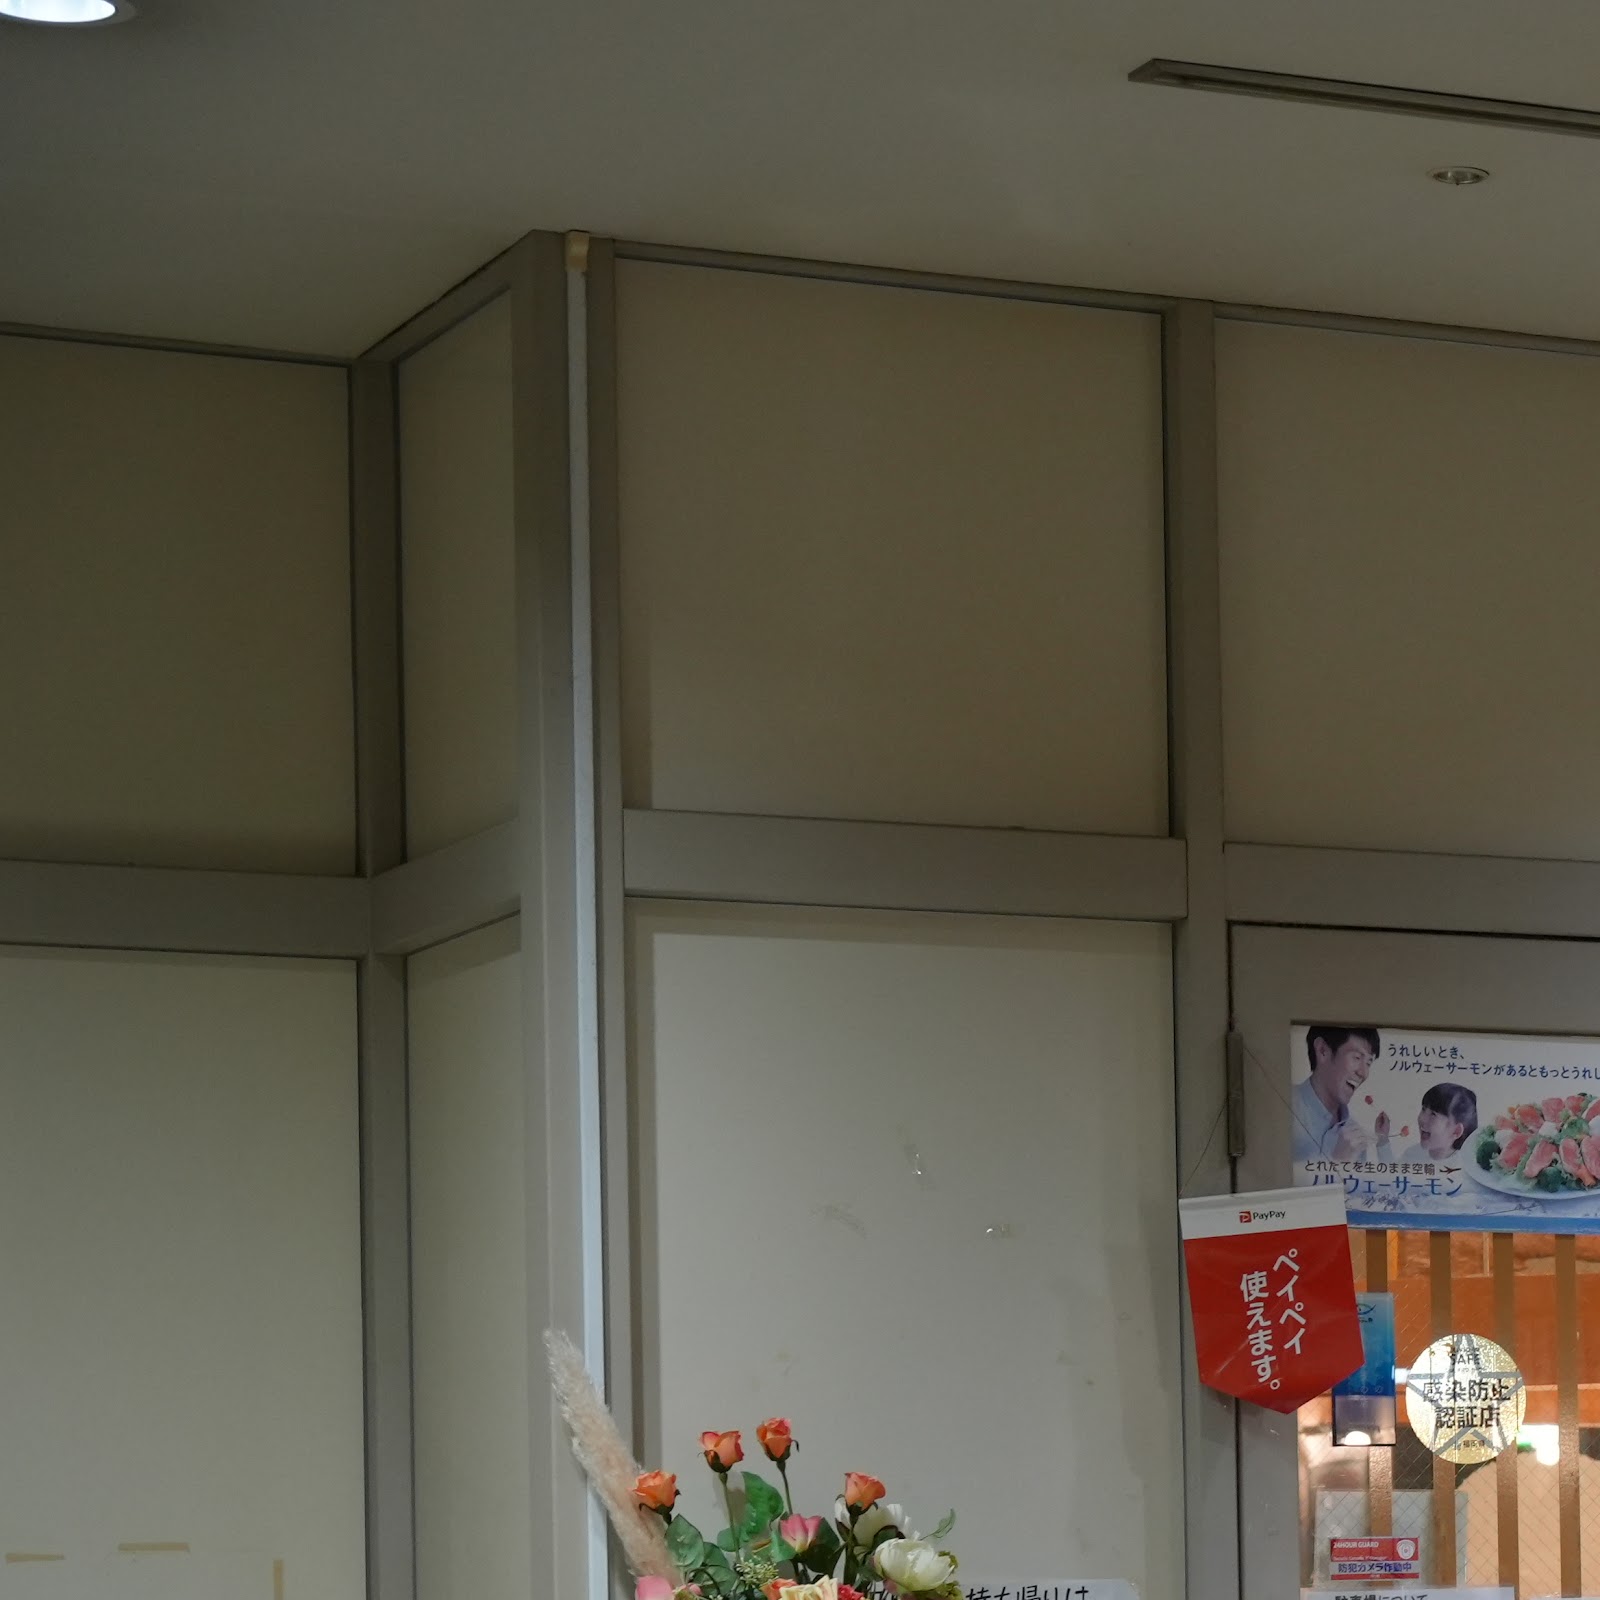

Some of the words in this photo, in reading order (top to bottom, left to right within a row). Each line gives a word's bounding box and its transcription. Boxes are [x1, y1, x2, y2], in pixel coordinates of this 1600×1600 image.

[1388, 1044, 1465, 1060] うれしいとき、
[1305, 1160, 1436, 1175] とれたてを生のまま空輸
[1253, 1211, 1286, 1220] PayPay
[1272, 1248, 1306, 1355] ペイペイ
[1240, 1271, 1281, 1390] 使えます。
[1423, 1379, 1511, 1402] 感染防止
[1435, 1406, 1500, 1429] 認証店
[1338, 1562, 1412, 1573] 防犯カメラ作動中
